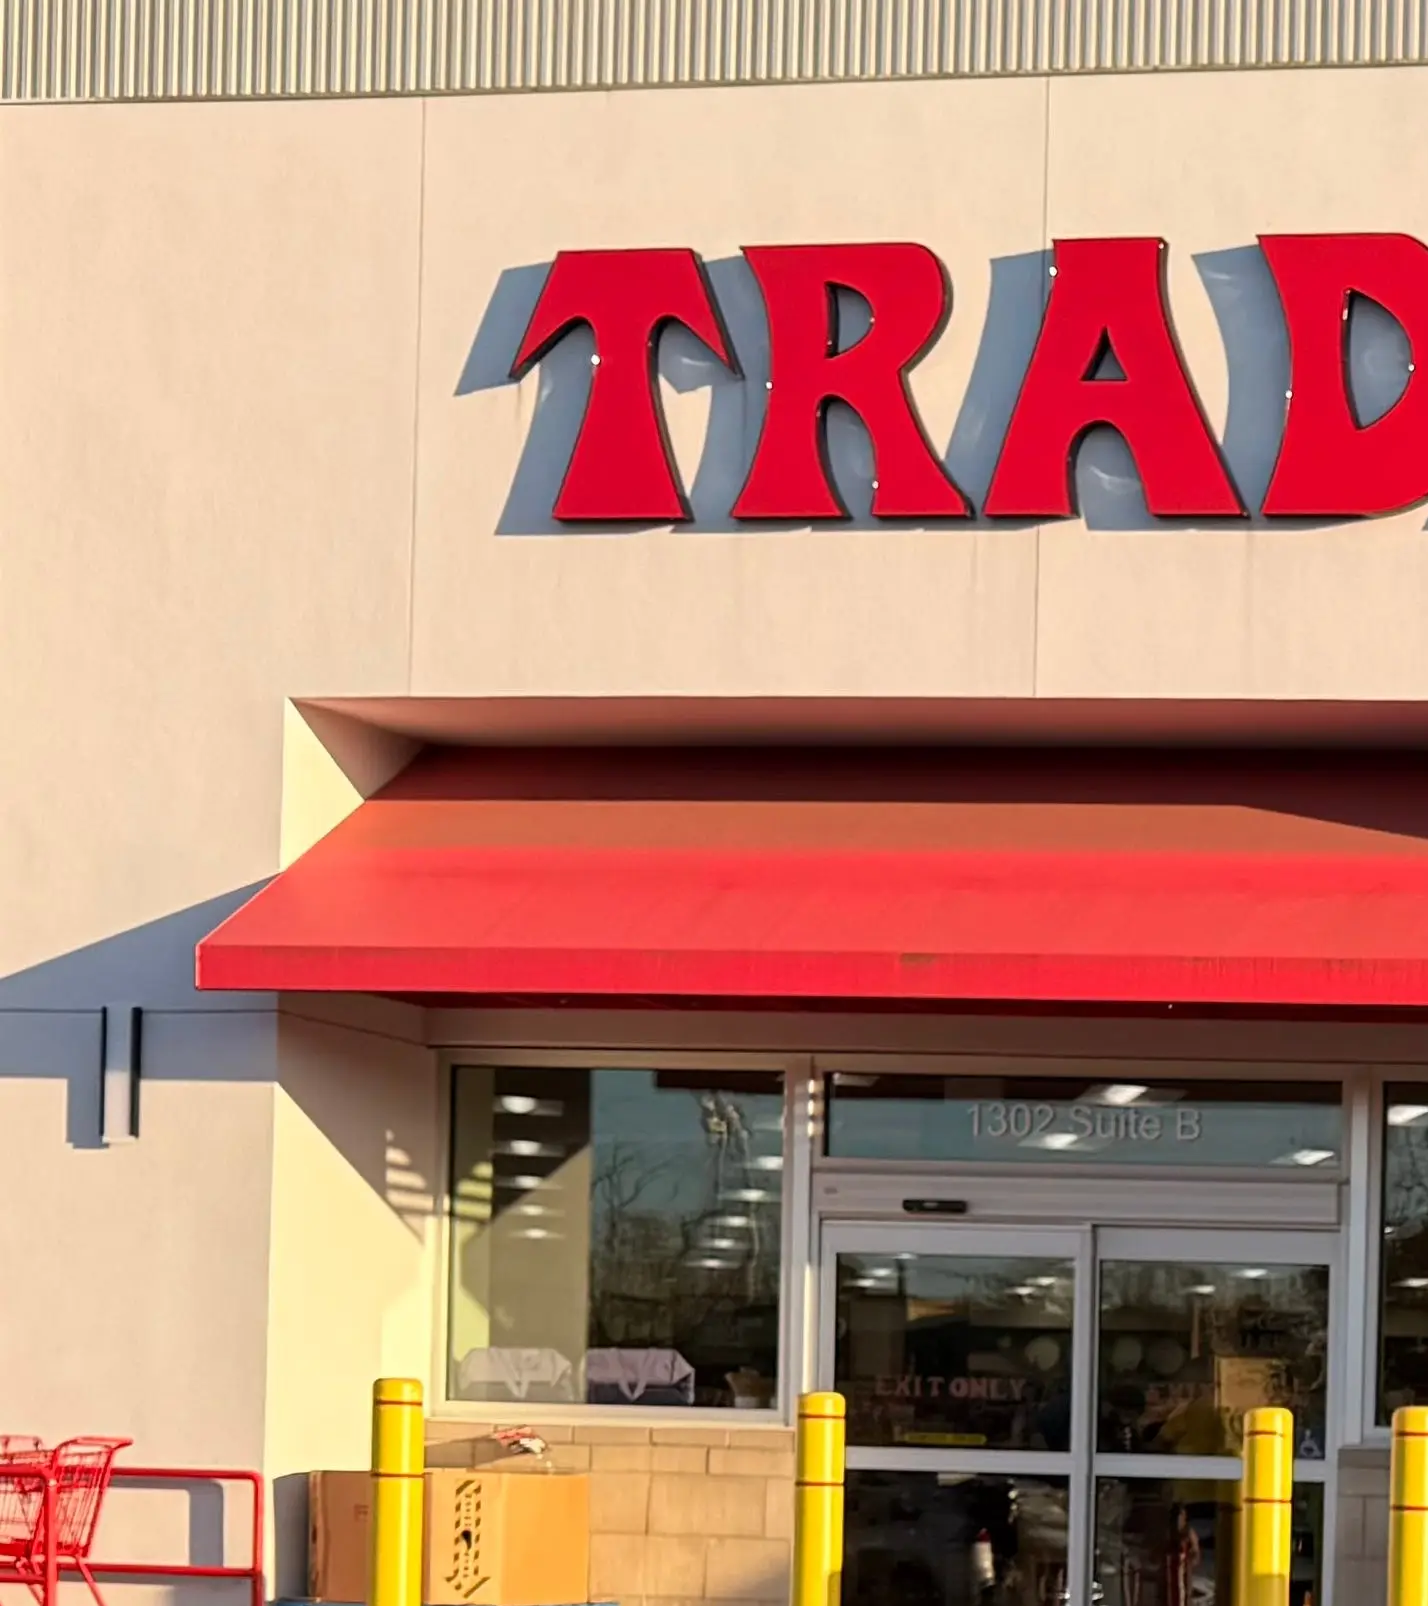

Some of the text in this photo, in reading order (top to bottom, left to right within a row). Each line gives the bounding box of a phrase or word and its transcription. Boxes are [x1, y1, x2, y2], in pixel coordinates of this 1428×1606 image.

[969, 1103, 1204, 1140] 1302 Suite B
[874, 1374, 1027, 1400] EXIT ONLY
